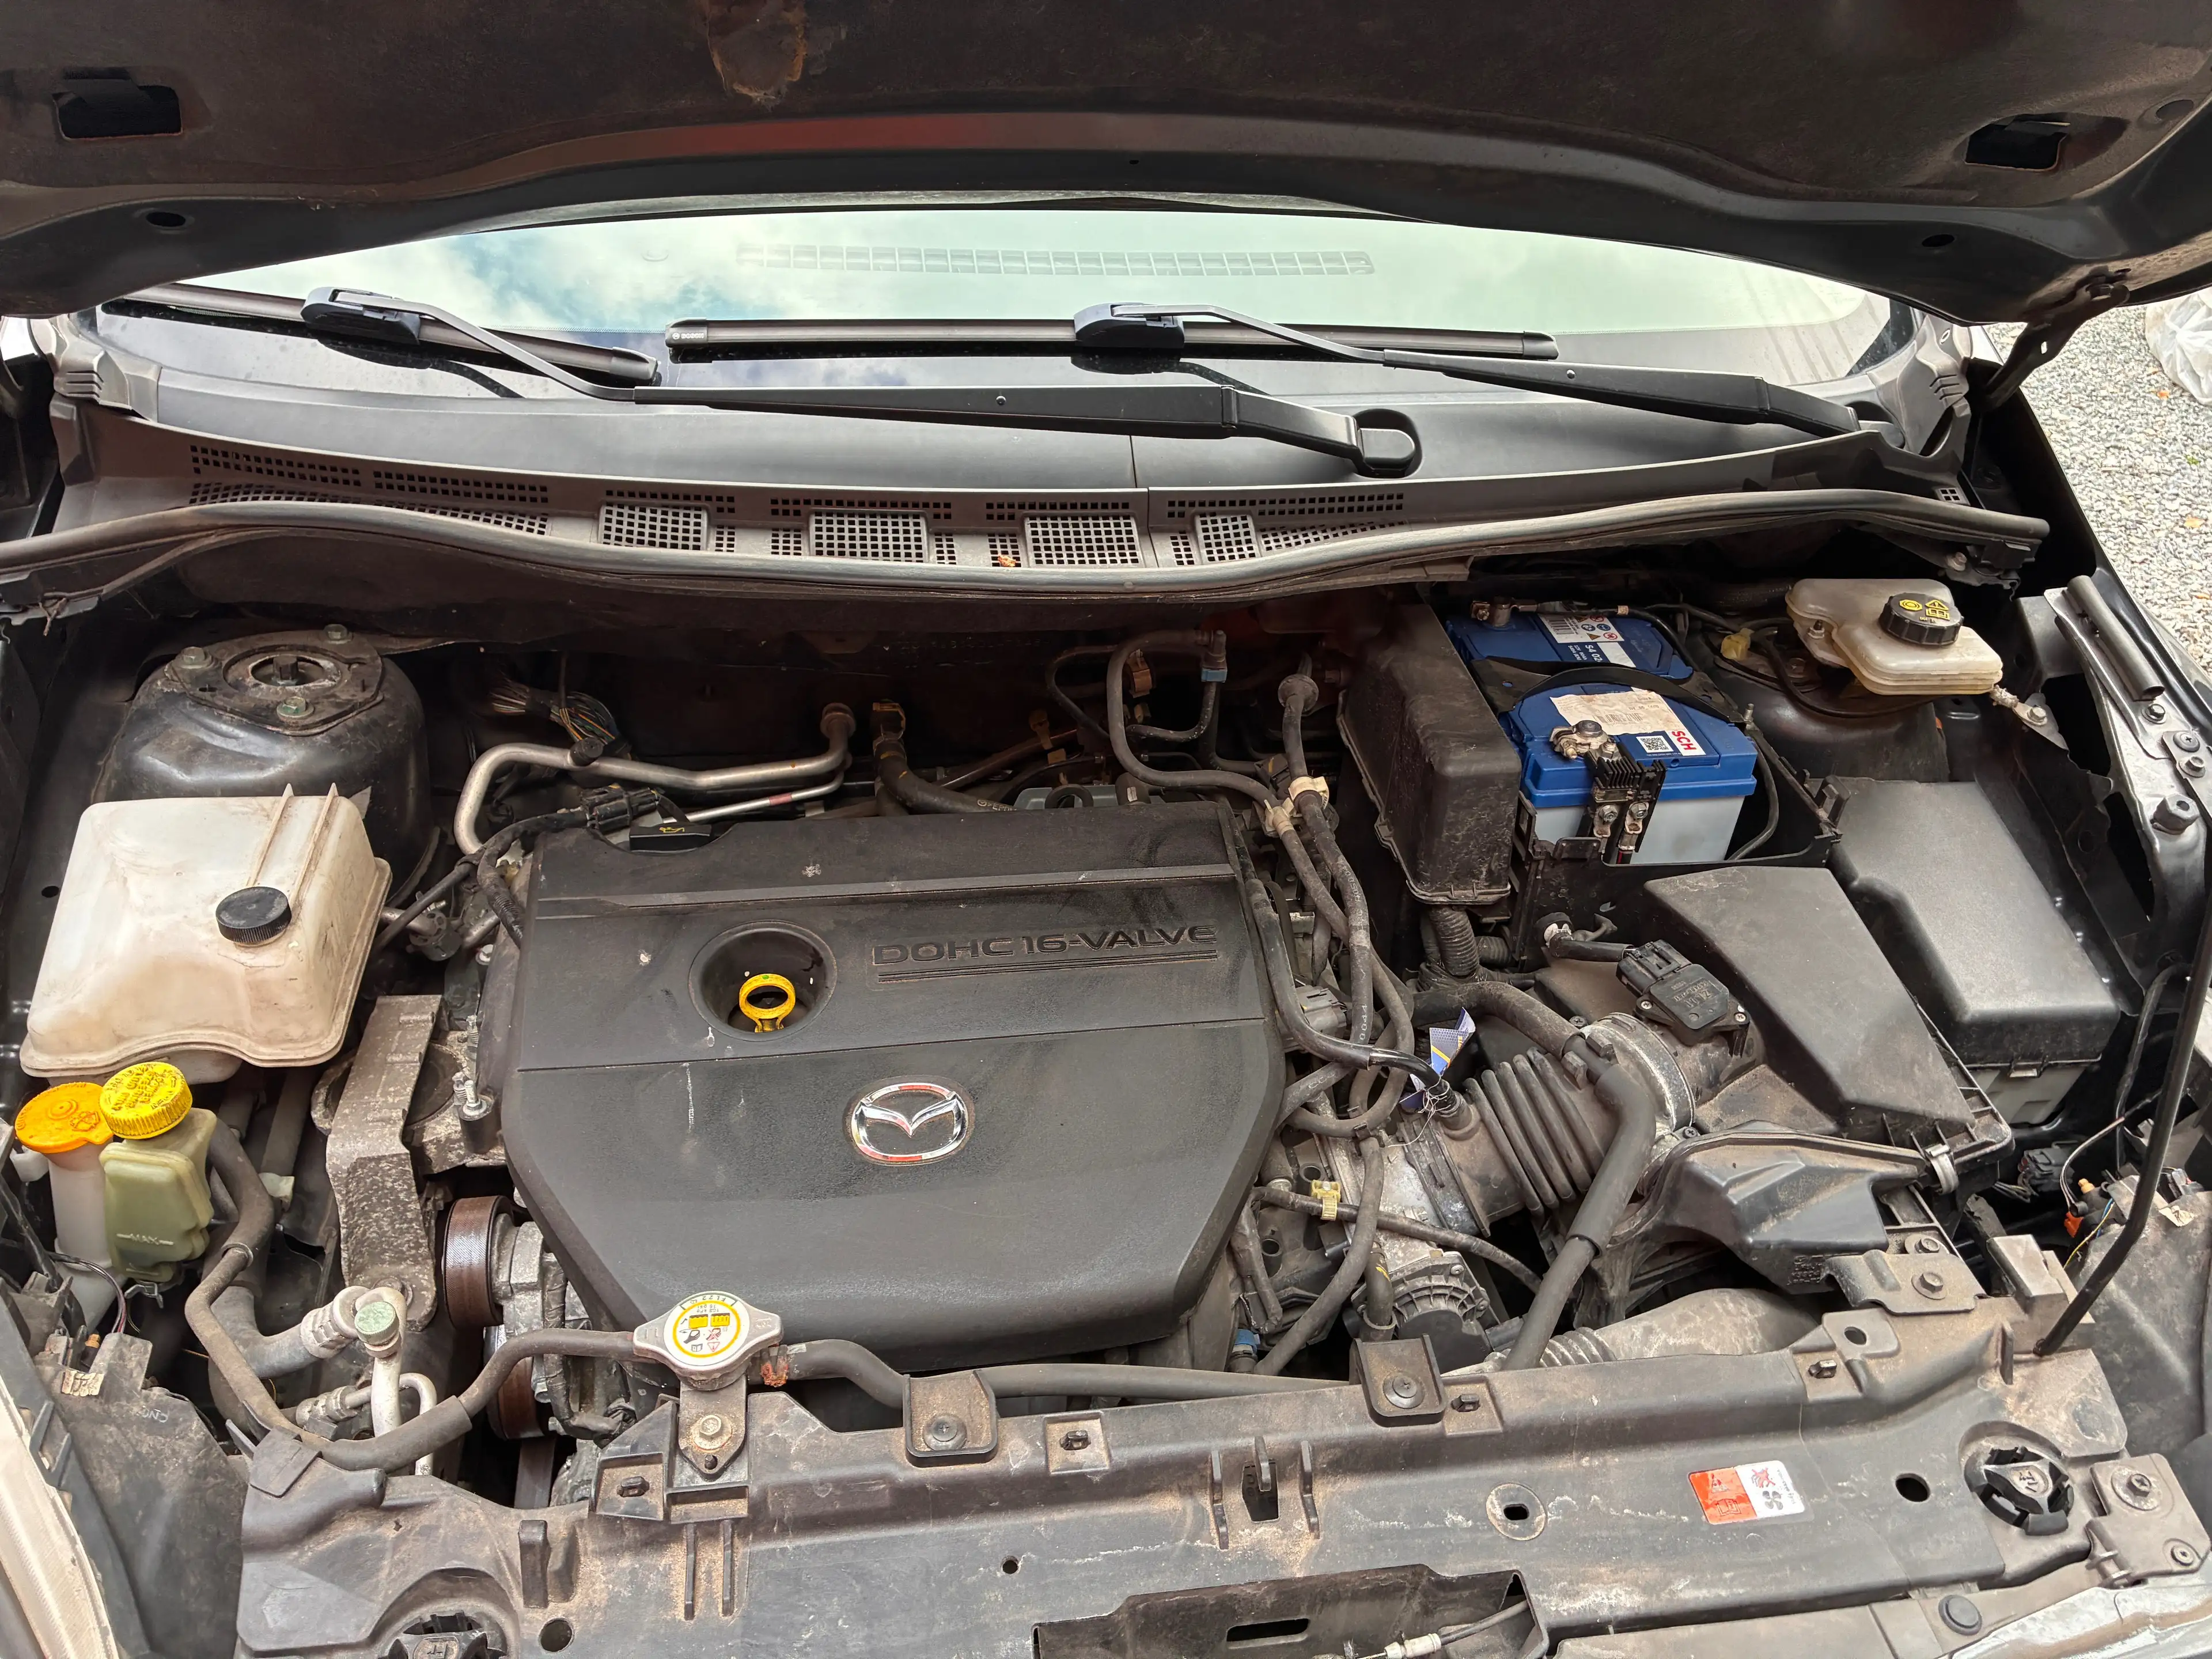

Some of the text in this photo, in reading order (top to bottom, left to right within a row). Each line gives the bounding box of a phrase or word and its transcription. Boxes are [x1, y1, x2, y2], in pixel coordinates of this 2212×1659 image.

[1585, 645, 1603, 662] S4 02
[1672, 730, 1697, 750] SCH
[872, 925, 1218, 966] DOHC 16-VALVE
